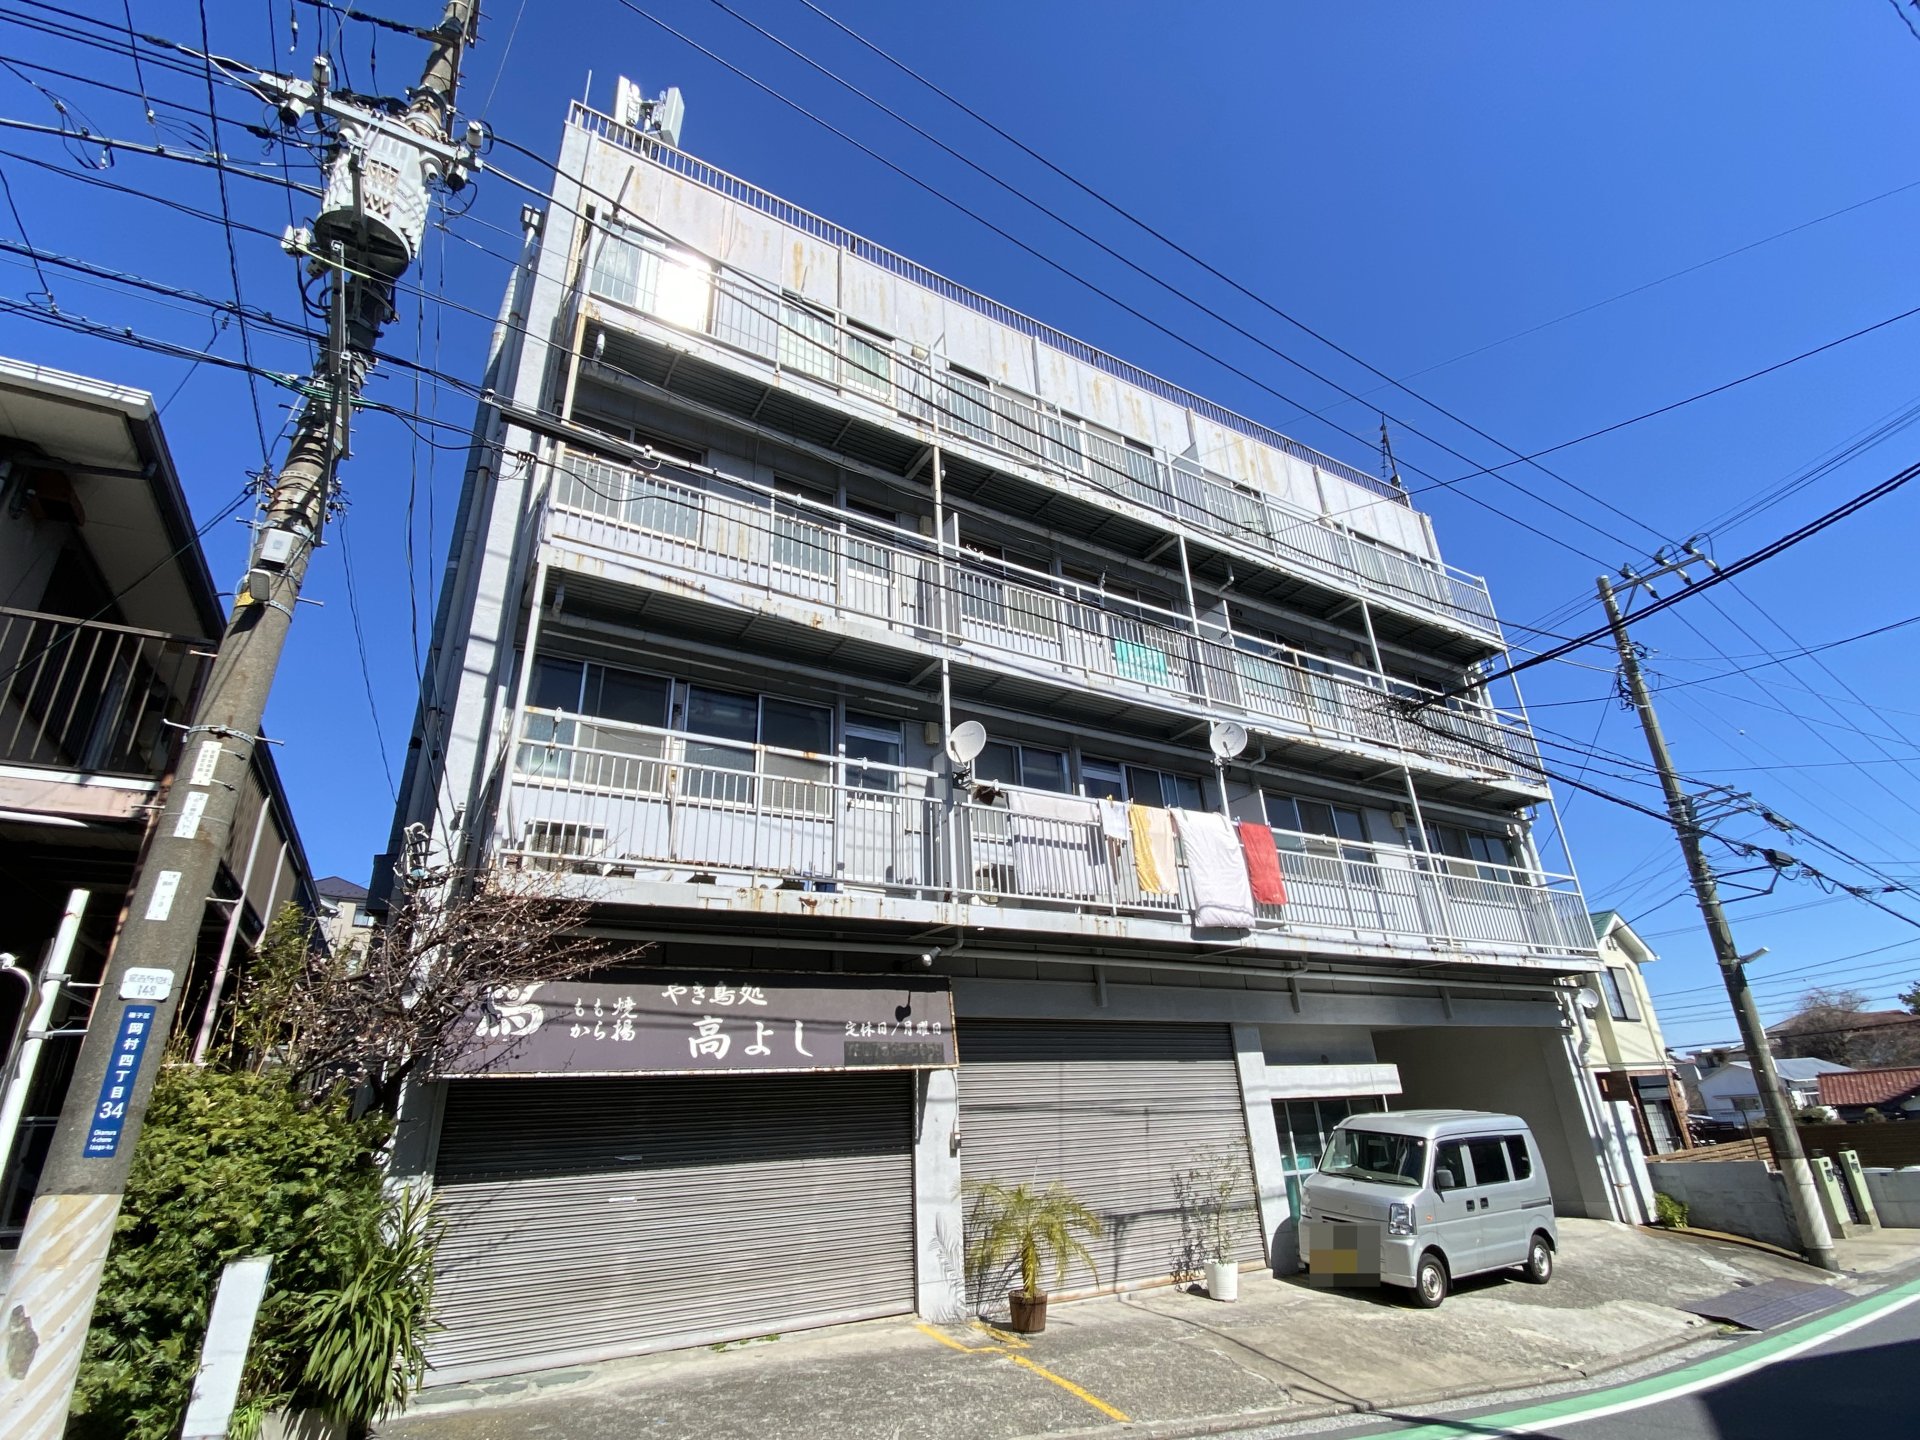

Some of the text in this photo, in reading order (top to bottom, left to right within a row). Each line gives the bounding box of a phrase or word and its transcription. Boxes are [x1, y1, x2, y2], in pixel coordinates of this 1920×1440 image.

[661, 981, 768, 1006] やき鳥処
[574, 997, 638, 1019] もも焼
[569, 1019, 636, 1042] から揚
[688, 1015, 814, 1060] 高よし
[110, 1022, 144, 1099] 岡村四丁目
[99, 1101, 125, 1119] 34
